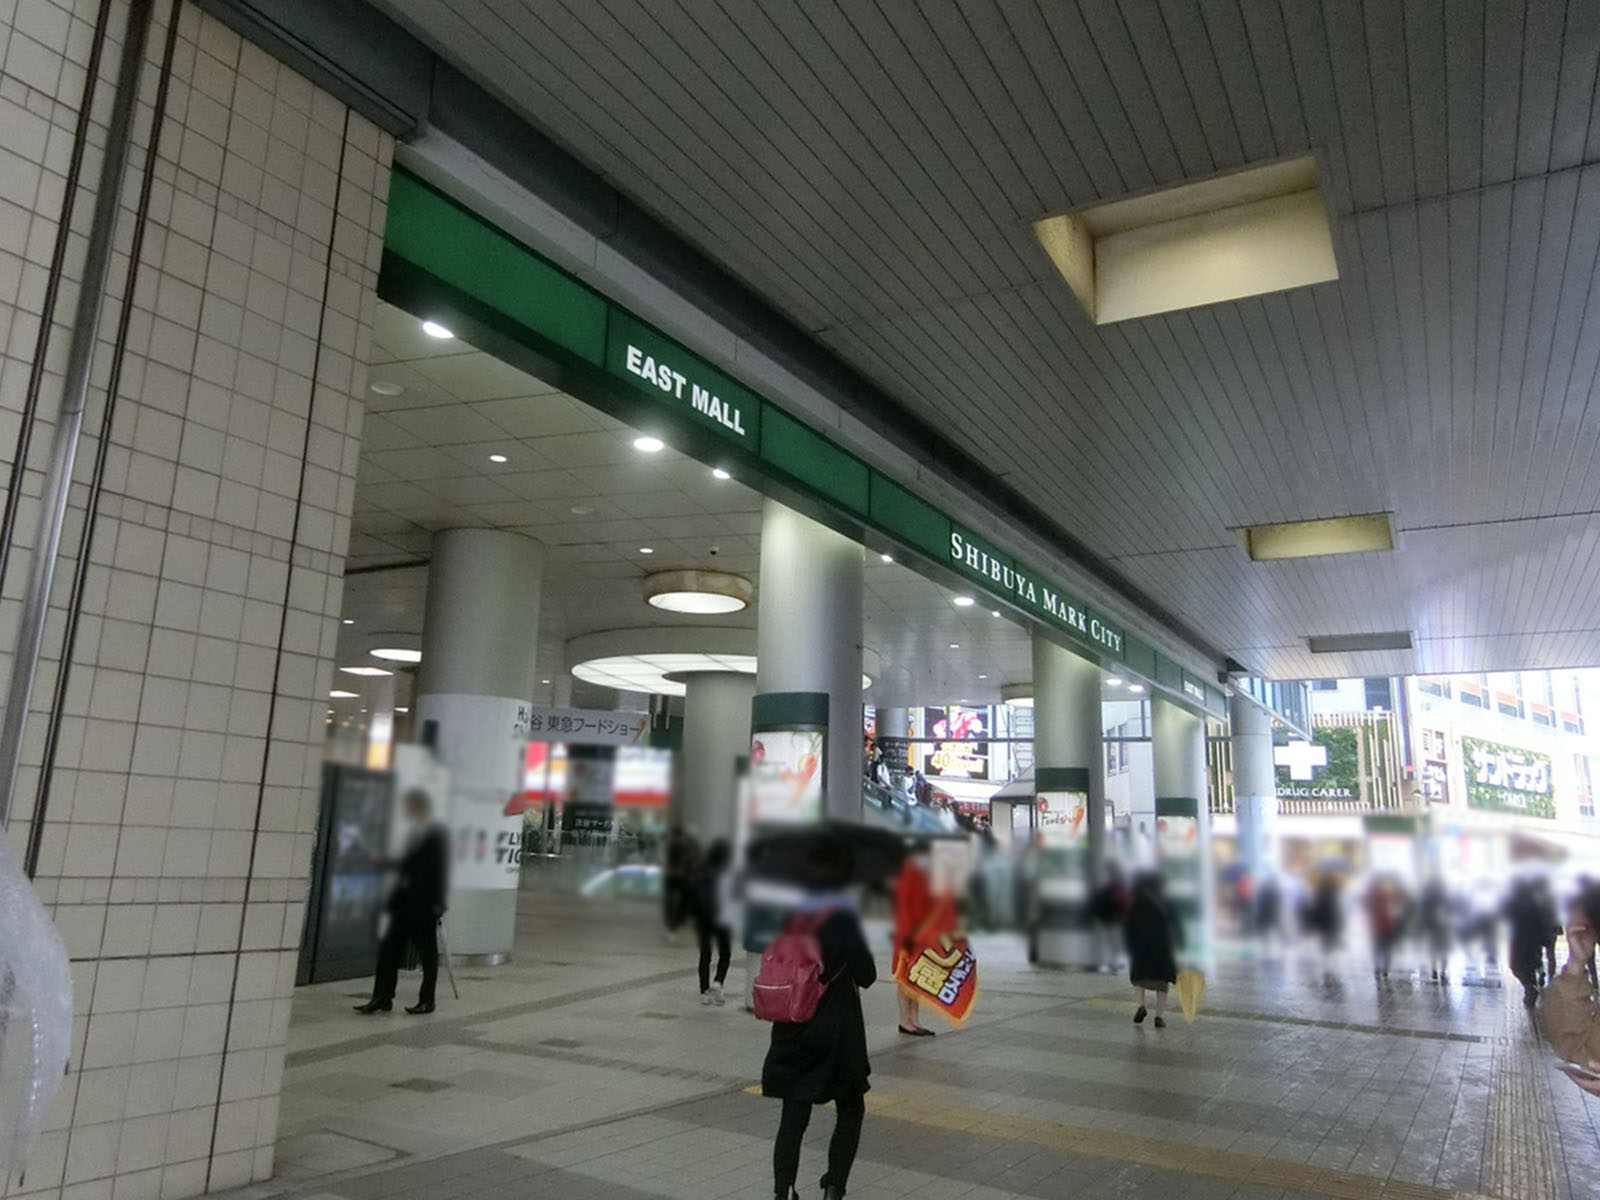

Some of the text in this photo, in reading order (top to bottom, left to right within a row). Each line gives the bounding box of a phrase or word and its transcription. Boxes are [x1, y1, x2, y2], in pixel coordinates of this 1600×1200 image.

[626, 344, 746, 437] EAST MALL
[951, 532, 1122, 652] SHIBUYA MARK CITY
[547, 715, 640, 737] 東急フードショー
